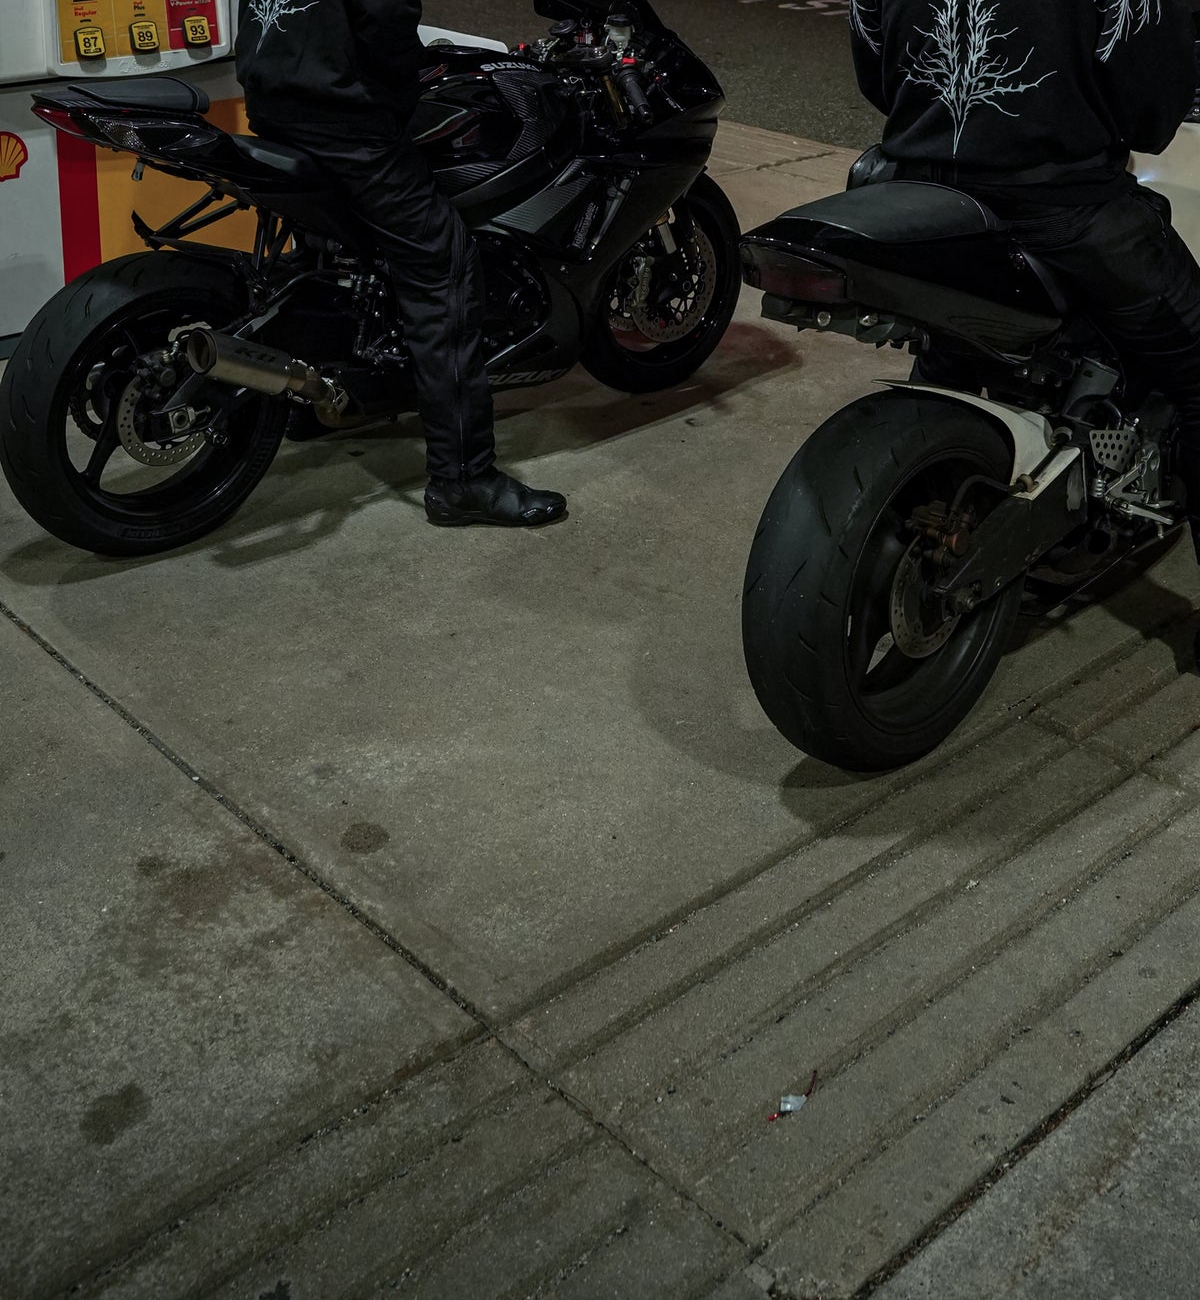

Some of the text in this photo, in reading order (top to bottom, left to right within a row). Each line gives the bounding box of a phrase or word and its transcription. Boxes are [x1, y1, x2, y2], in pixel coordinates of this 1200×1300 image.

[138, 30, 153, 42] 89
[190, 25, 205, 36] 93
[83, 36, 98, 48] 87
